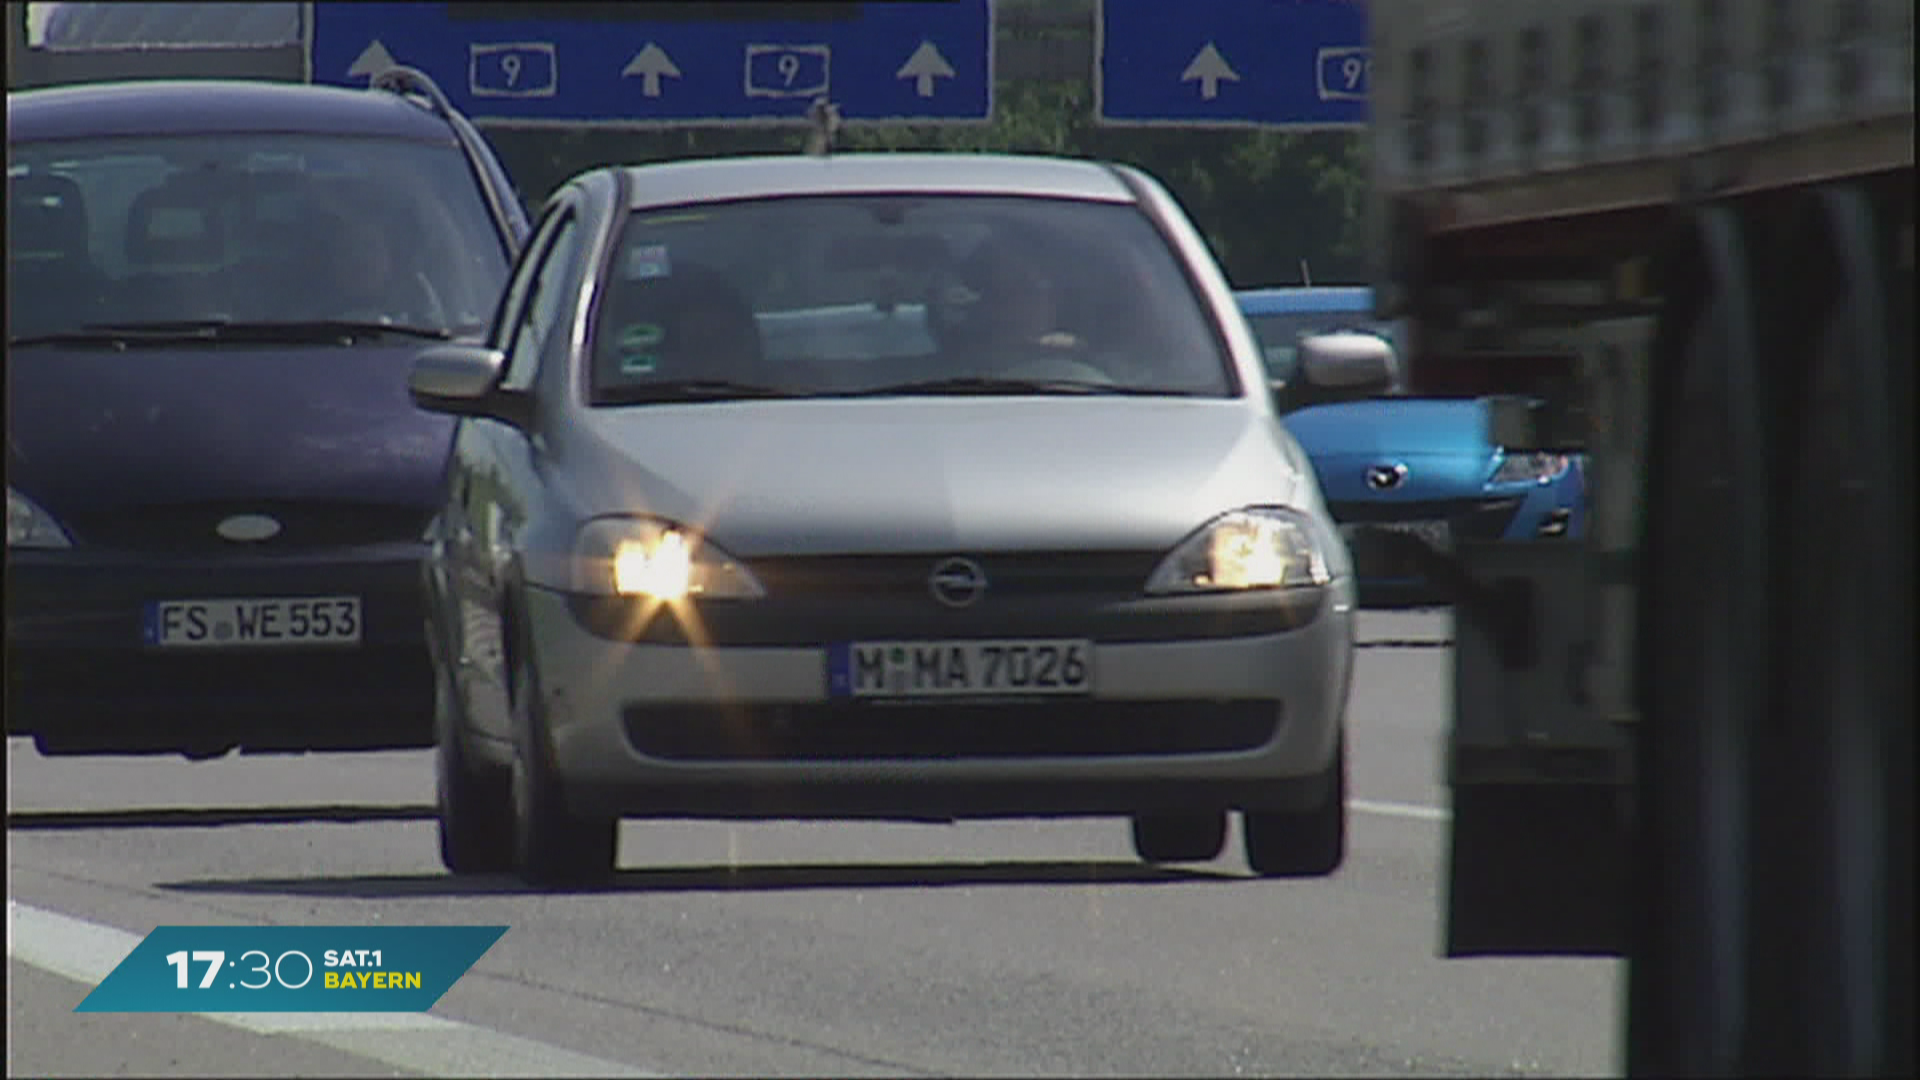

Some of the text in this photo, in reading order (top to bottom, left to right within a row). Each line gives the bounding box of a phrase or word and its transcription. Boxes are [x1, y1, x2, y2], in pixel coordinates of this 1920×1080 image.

[501, 54, 521, 87] 9
[778, 54, 799, 87] 9
[162, 602, 355, 641] FS WE 553
[857, 646, 1087, 689] M MA 7026
